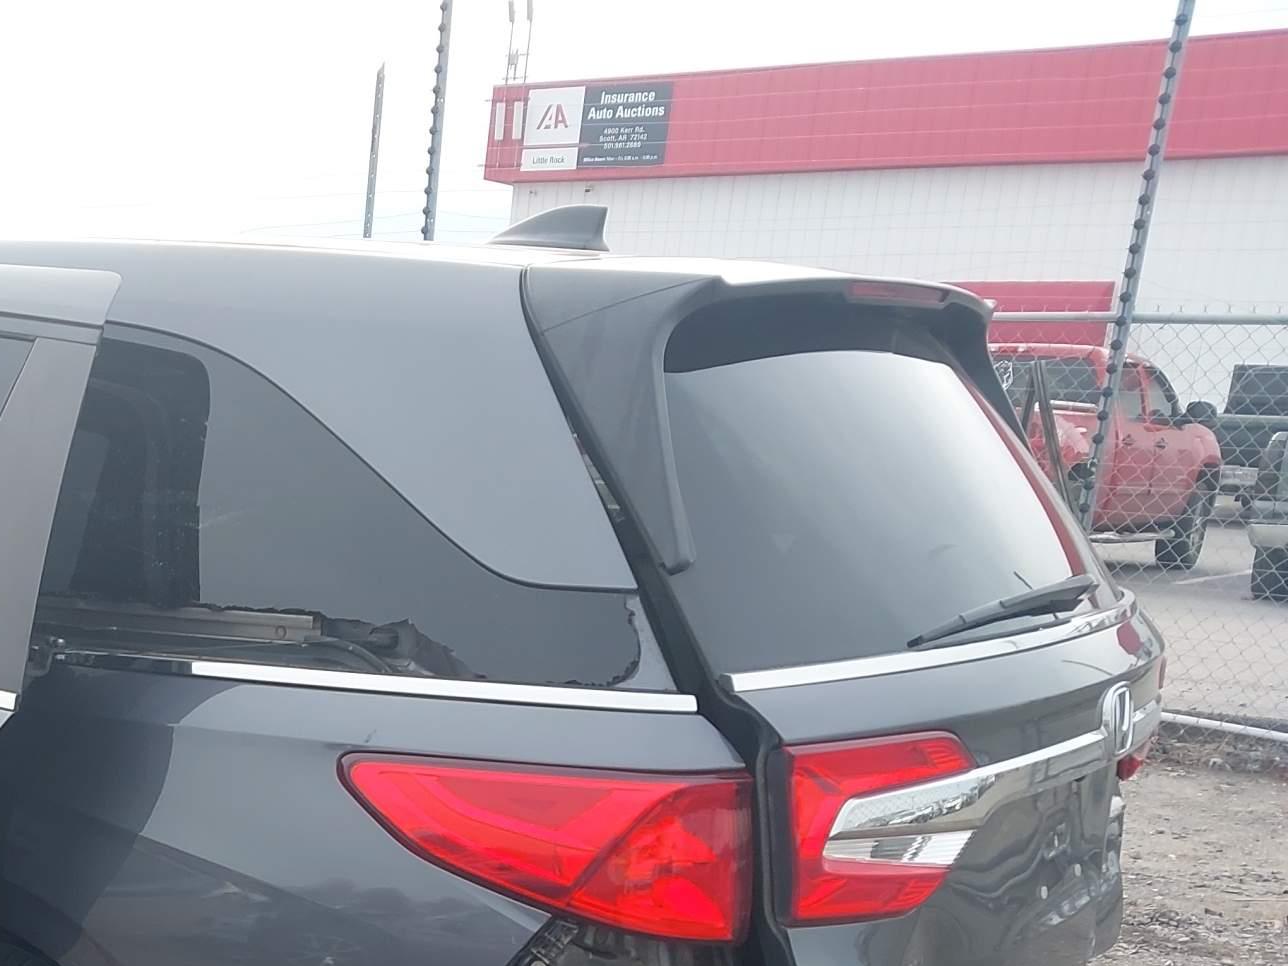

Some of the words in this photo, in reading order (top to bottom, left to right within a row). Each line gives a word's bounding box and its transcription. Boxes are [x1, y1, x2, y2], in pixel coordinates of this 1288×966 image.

[600, 91, 656, 105] Insurance
[587, 107, 612, 120] Auto
[615, 104, 665, 118] Auctions
[532, 156, 549, 165] Little
[549, 155, 565, 164] Rock
